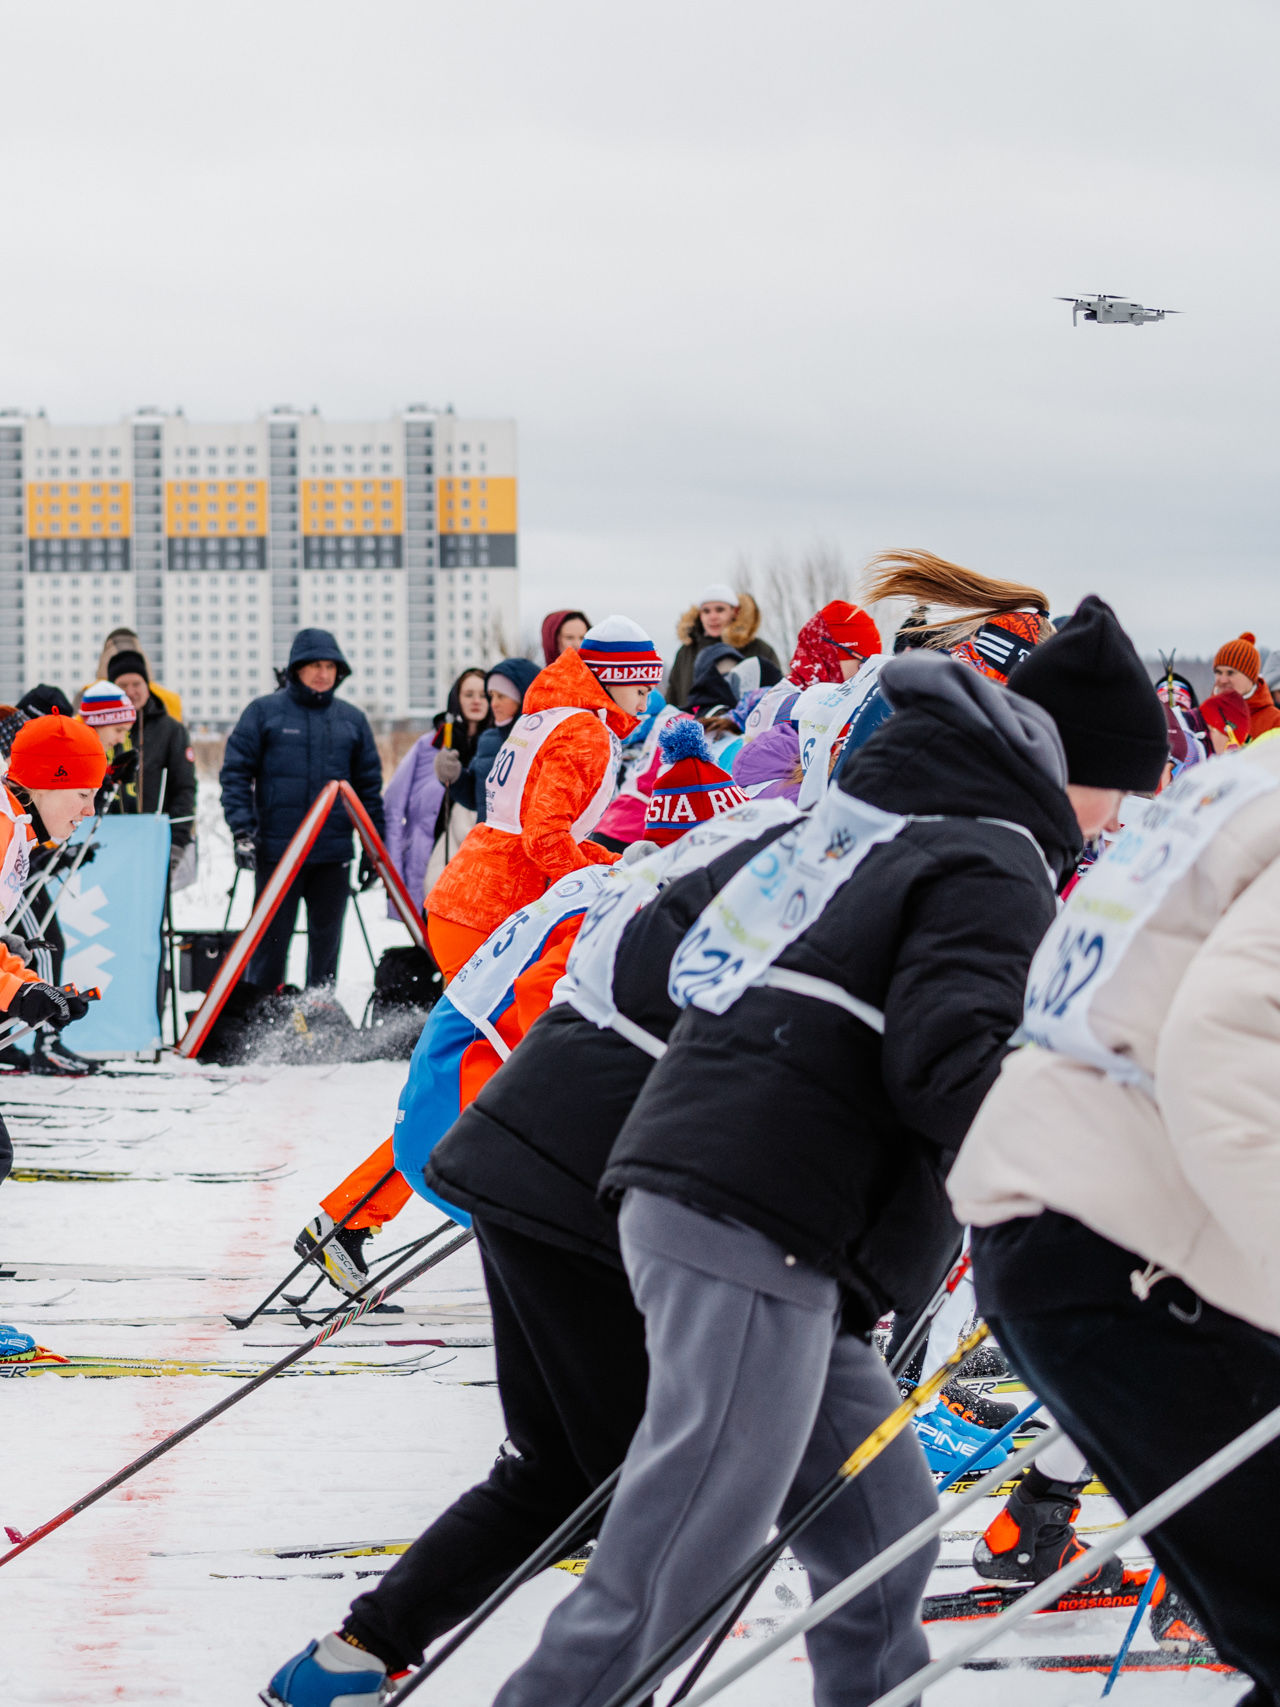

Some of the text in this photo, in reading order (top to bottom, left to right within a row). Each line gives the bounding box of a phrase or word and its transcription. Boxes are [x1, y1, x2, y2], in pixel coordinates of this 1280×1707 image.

[598, 666, 663, 679] ЛЫЖНЯ
[645, 794, 697, 822] SIA
[330, 1244, 365, 1286] FISCHE
